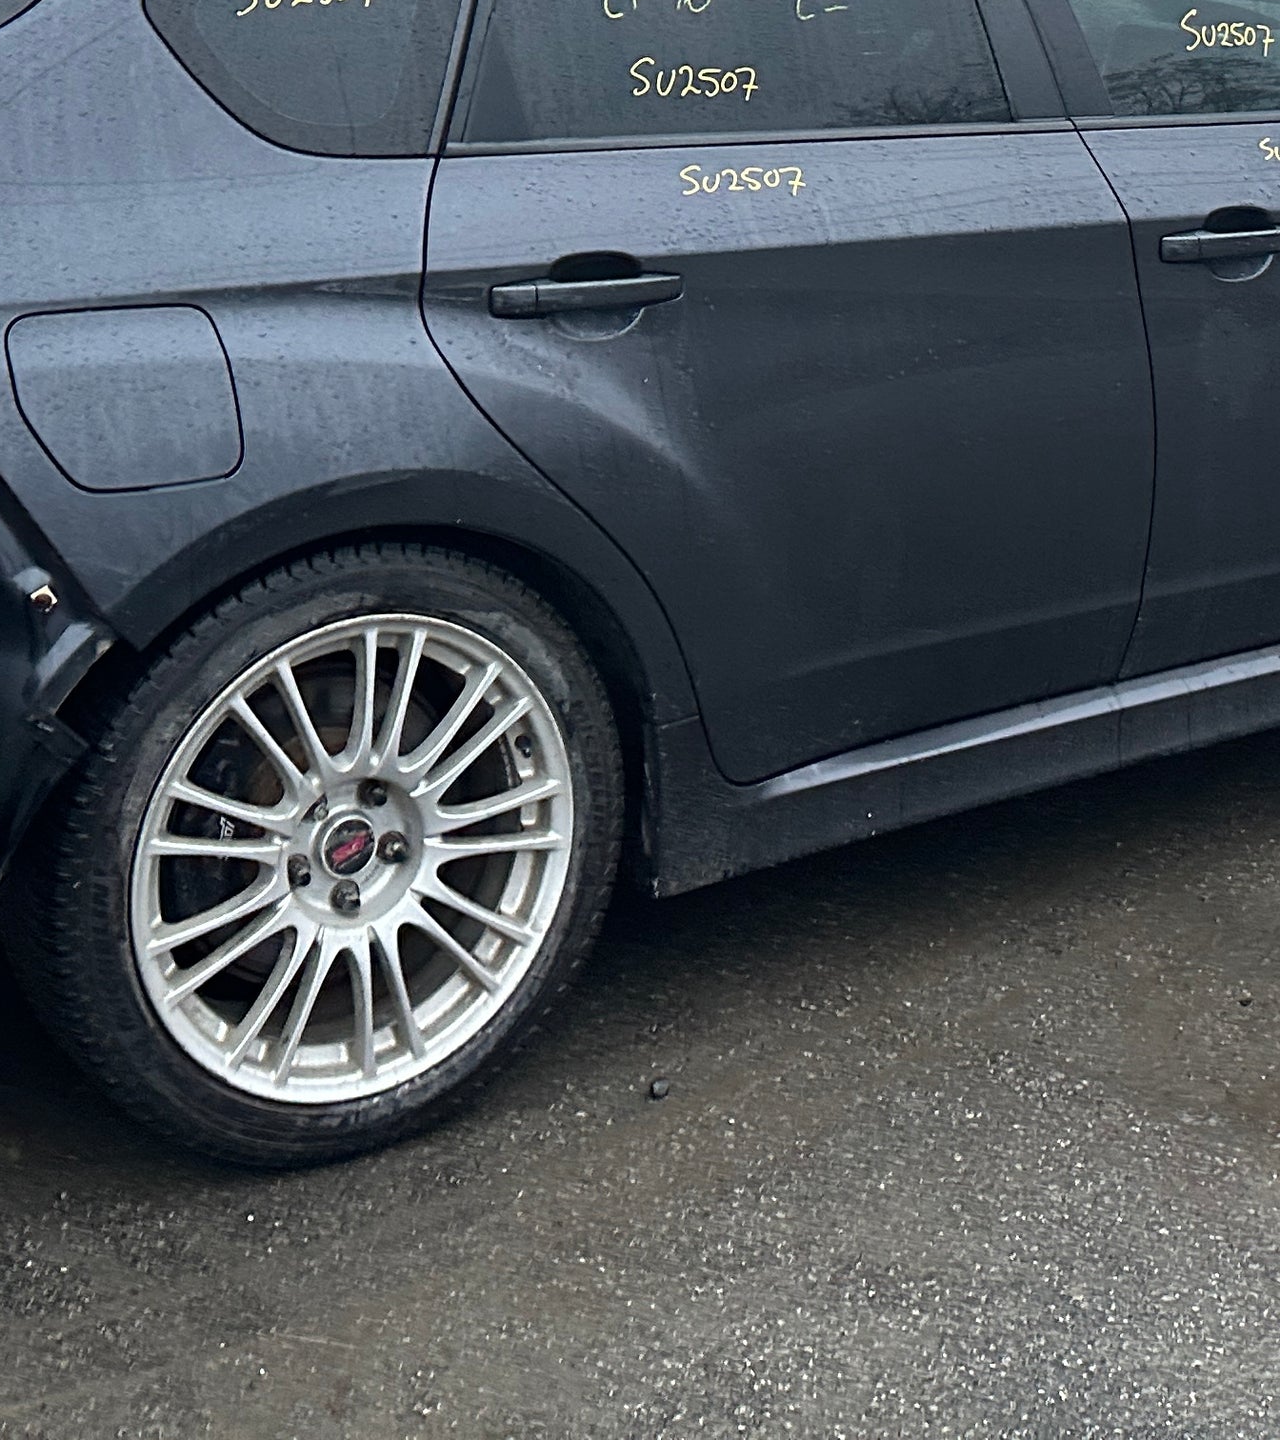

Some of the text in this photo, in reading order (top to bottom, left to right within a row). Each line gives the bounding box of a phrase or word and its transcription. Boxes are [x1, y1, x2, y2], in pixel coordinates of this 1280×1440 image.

[1180, 8, 1275, 57] SU2507
[629, 55, 759, 101] SU2507
[679, 164, 807, 197] SU2507
